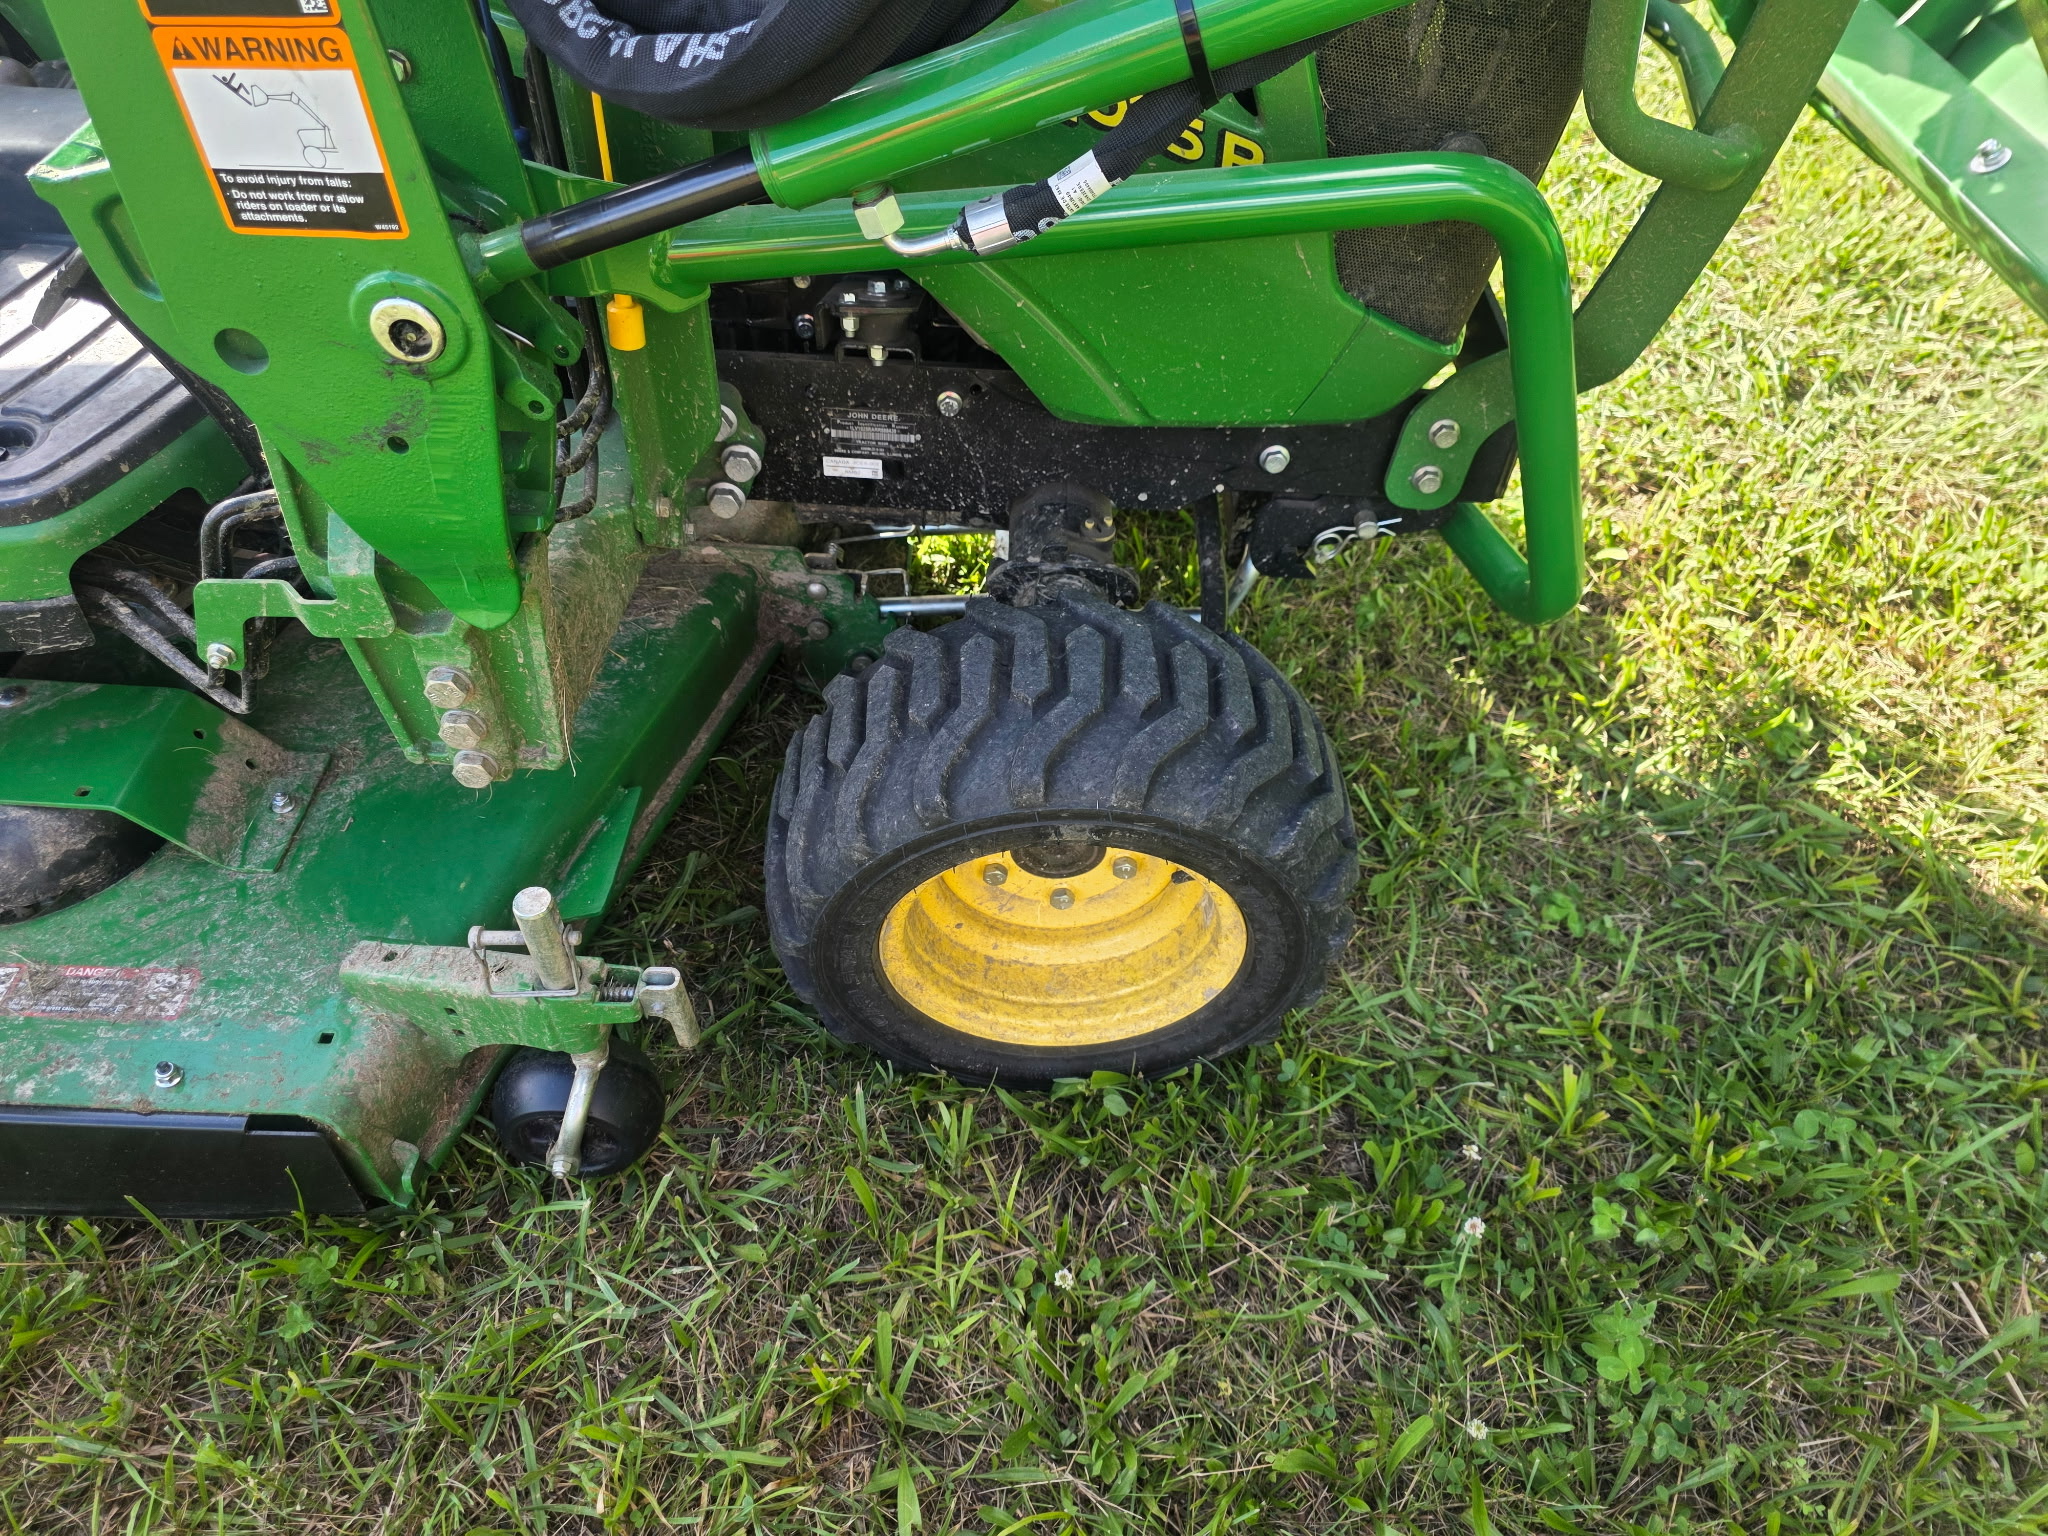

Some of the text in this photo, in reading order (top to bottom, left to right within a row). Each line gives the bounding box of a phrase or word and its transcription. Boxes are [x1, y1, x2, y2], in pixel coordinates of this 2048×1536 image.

[191, 37, 343, 62] WARNING
[219, 173, 352, 188] To avoid injury from falls:
[231, 189, 364, 204] Do not work from or allow
[236, 201, 347, 213] riders on loader or its
[241, 212, 308, 222] attachments.
[871, 413, 899, 421] DEERE
